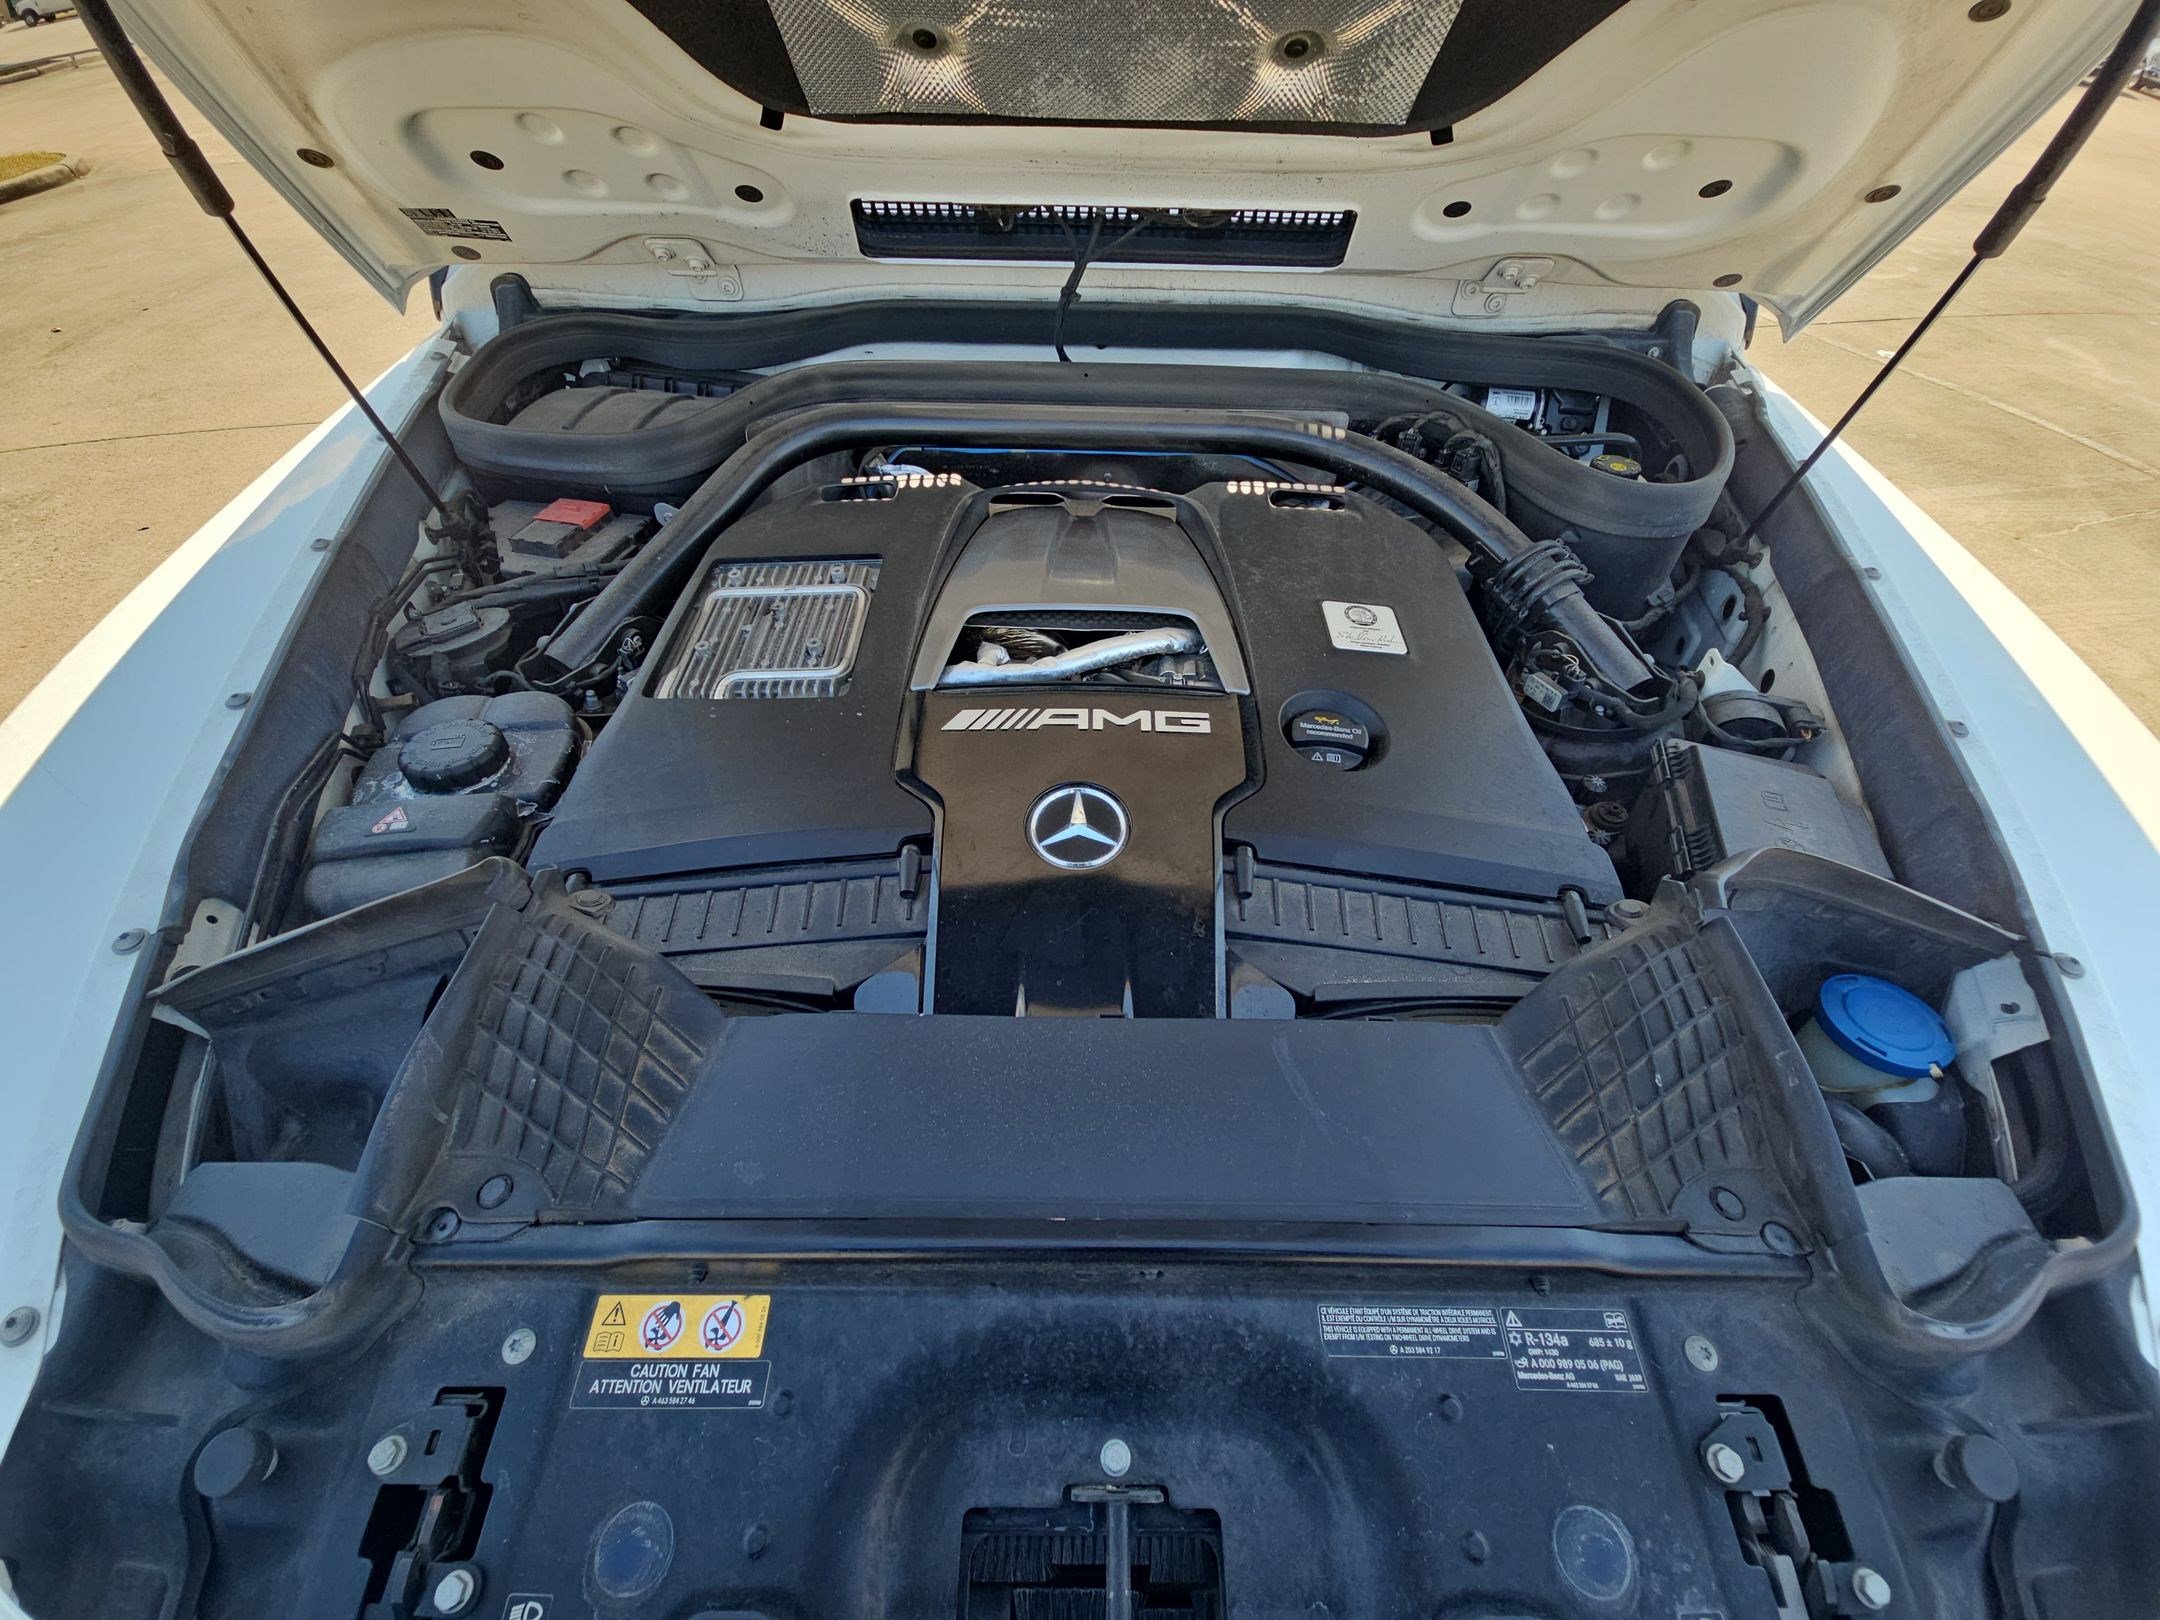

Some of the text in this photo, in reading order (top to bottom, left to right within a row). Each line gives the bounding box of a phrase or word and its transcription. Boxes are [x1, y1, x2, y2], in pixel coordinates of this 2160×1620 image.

[1026, 708, 1212, 734] AMG
[1300, 722, 1351, 734] Mercedes-Benz
[1306, 729, 1354, 740] recommended
[1524, 1332, 1569, 1347] R-134a
[1589, 1337, 1605, 1347] 685
[1614, 1338, 1625, 1347] 10
[1626, 1340, 1633, 1350] g
[1545, 1348, 1559, 1356] 1430
[630, 1363, 720, 1378] CAUTION FAN
[1531, 1359, 1624, 1372] A 000 989 05 06 (PAG)
[589, 1379, 752, 1394] ATTENTION VENTILATEUR
[680, 1397, 687, 1405] 27
